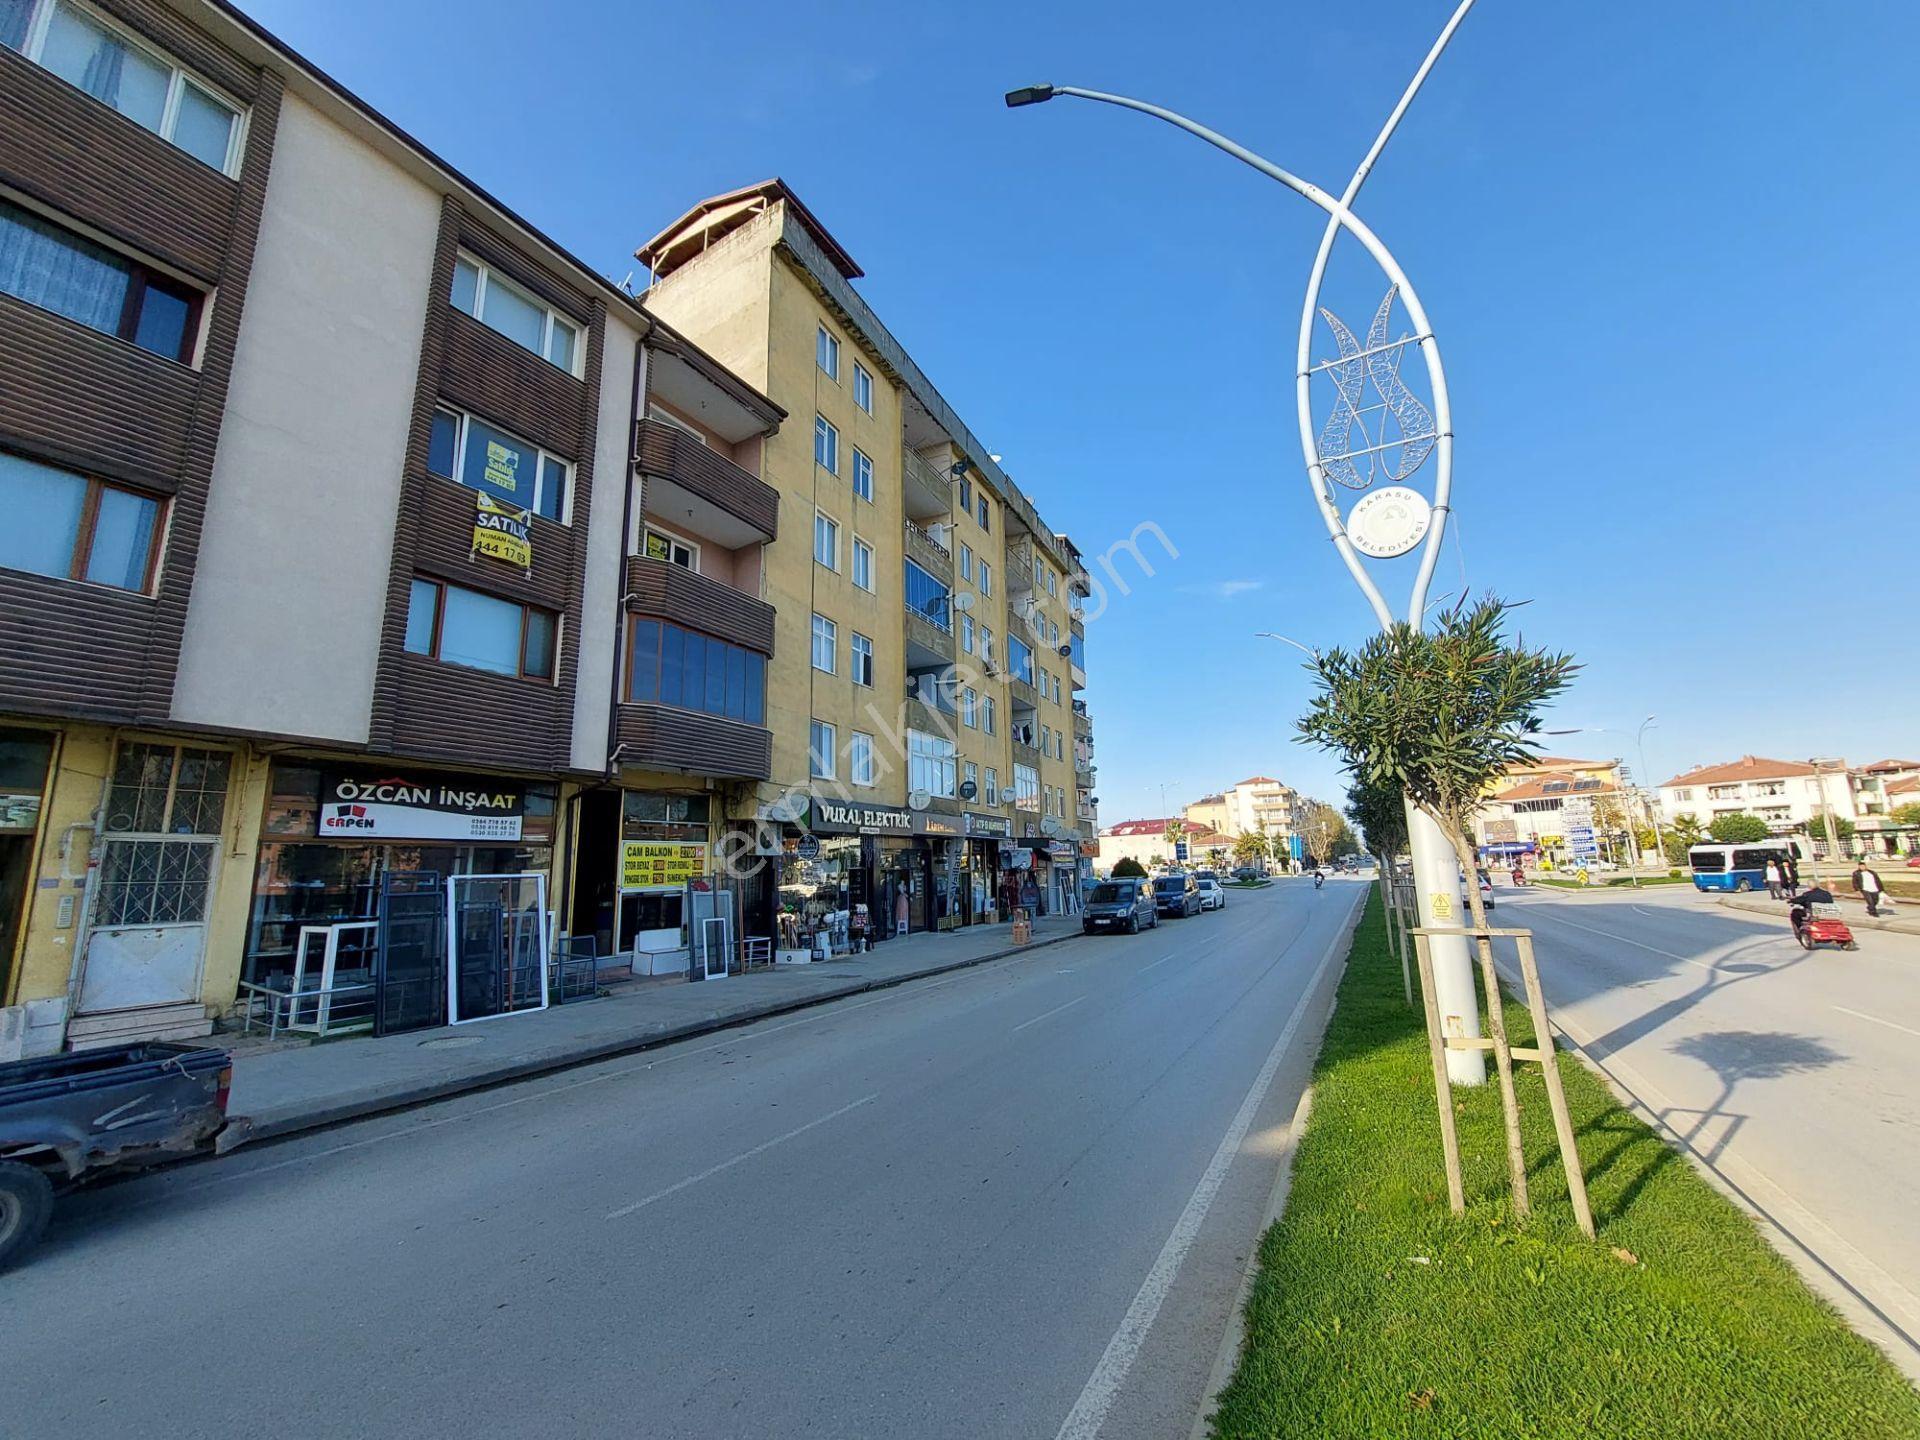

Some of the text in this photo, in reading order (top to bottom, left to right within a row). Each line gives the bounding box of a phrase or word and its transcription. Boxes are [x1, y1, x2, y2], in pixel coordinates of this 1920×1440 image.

[1359, 492, 1411, 513] KARASU
[476, 512, 529, 542] SATILIK
[480, 532, 507, 543] NUMAN
[474, 540, 499, 554] 444
[504, 546, 516, 558] 17
[336, 778, 516, 811] ÖZCAN İNŞAAT
[326, 817, 375, 829] ERPEN
[821, 805, 911, 829] VURAL ELEKTRİK
[627, 846, 643, 857] CAM
[645, 846, 673, 857] BALKON
